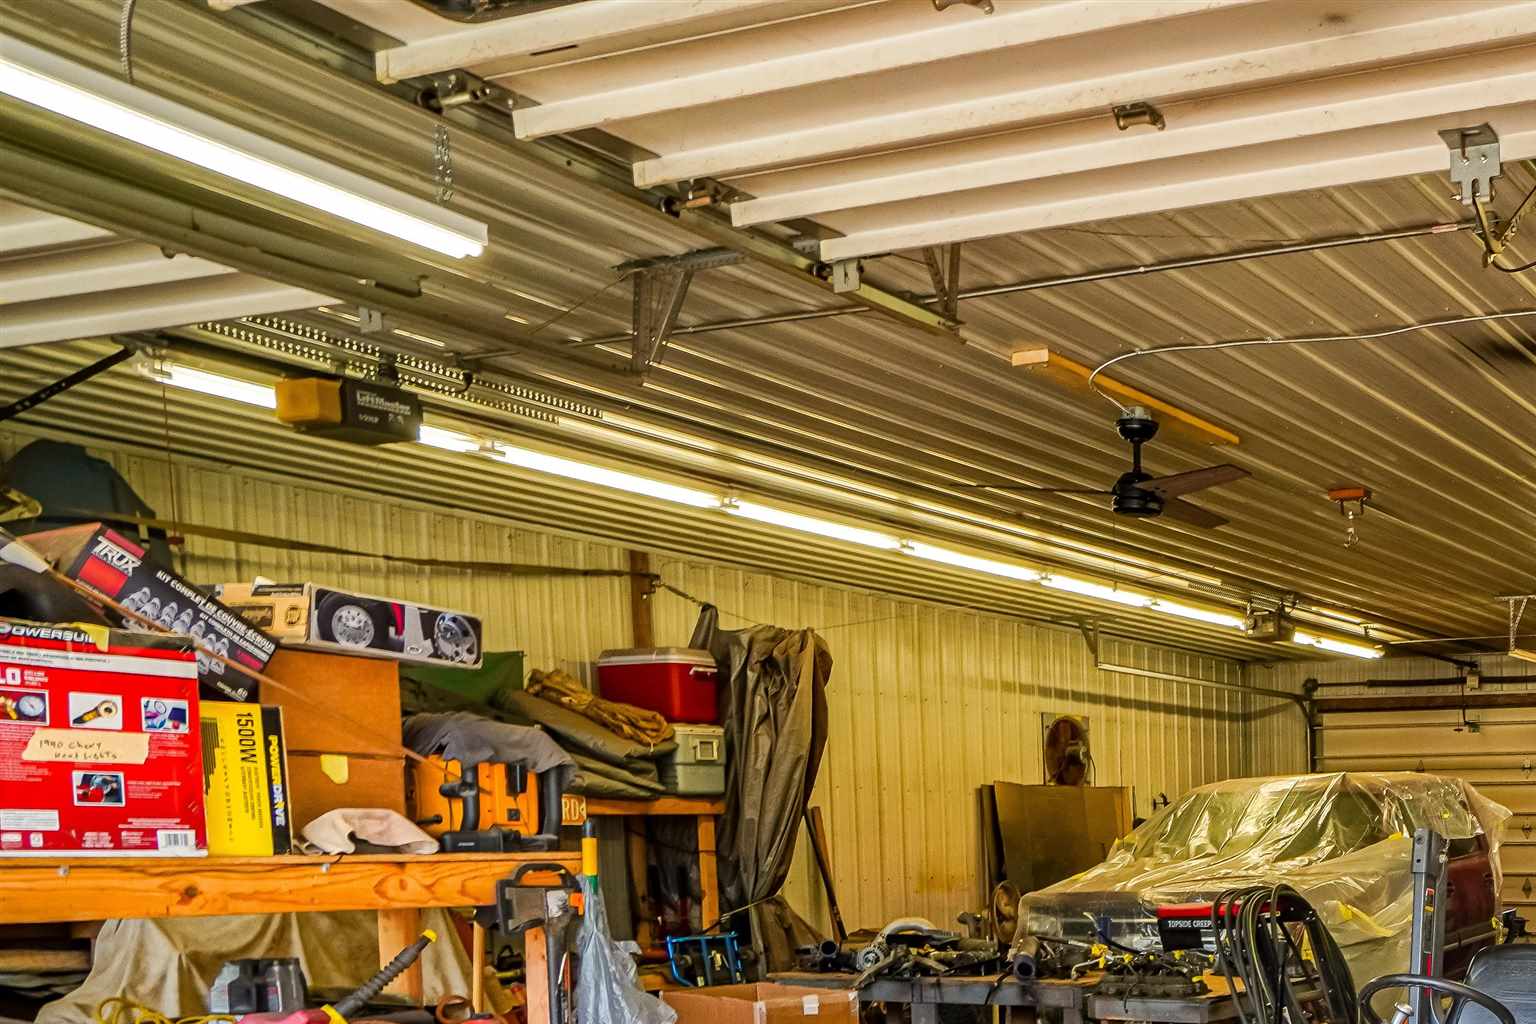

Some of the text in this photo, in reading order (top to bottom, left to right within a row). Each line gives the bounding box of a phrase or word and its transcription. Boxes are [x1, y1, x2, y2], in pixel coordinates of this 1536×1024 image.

[91, 535, 143, 577] TRUX
[0, 623, 98, 643] POWERSUI
[235, 712, 258, 764] 1500W
[268, 734, 286, 827] POWERDRIVE
[1168, 919, 1216, 928] TOPSIDE CREEP
